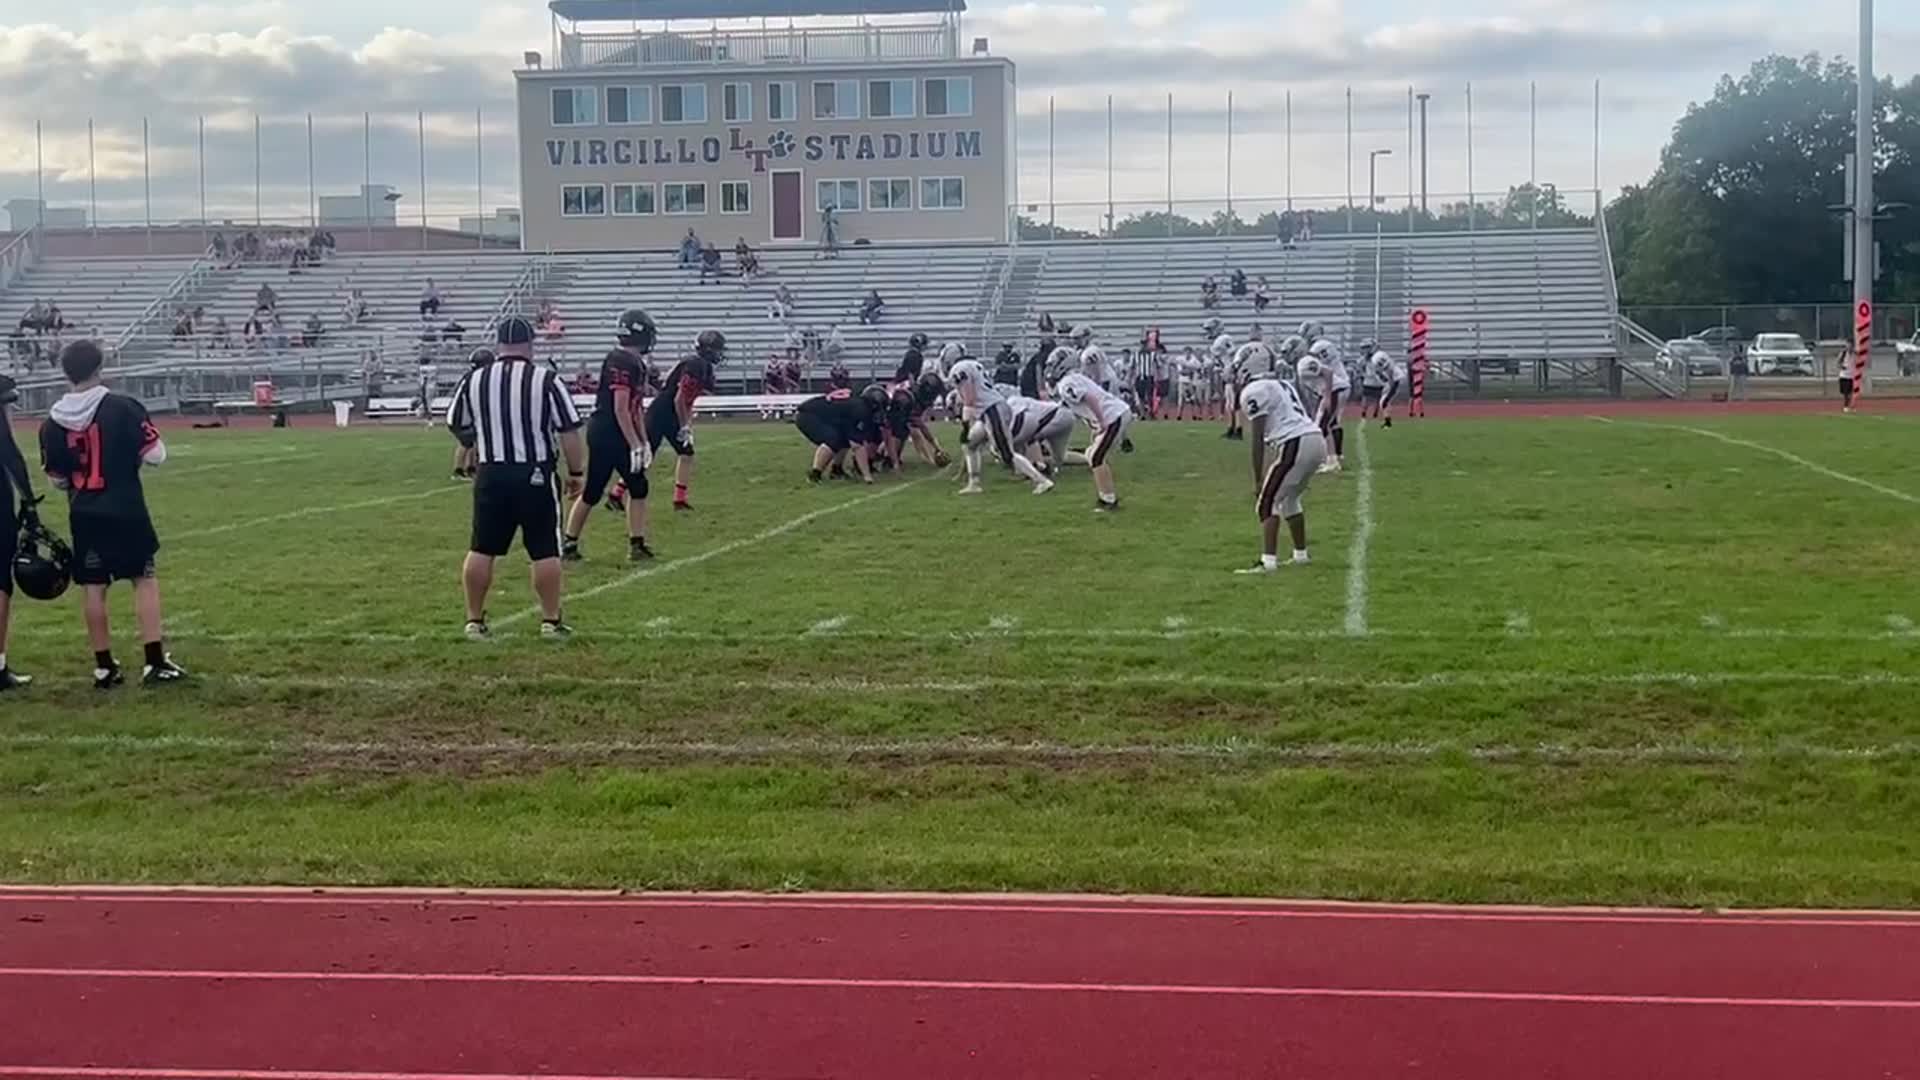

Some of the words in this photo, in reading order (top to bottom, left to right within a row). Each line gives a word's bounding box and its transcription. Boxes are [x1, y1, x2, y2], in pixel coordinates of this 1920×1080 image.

[804, 130, 983, 162] STADIUM
[1247, 399, 1260, 415] 3
[66, 422, 106, 491] 31
